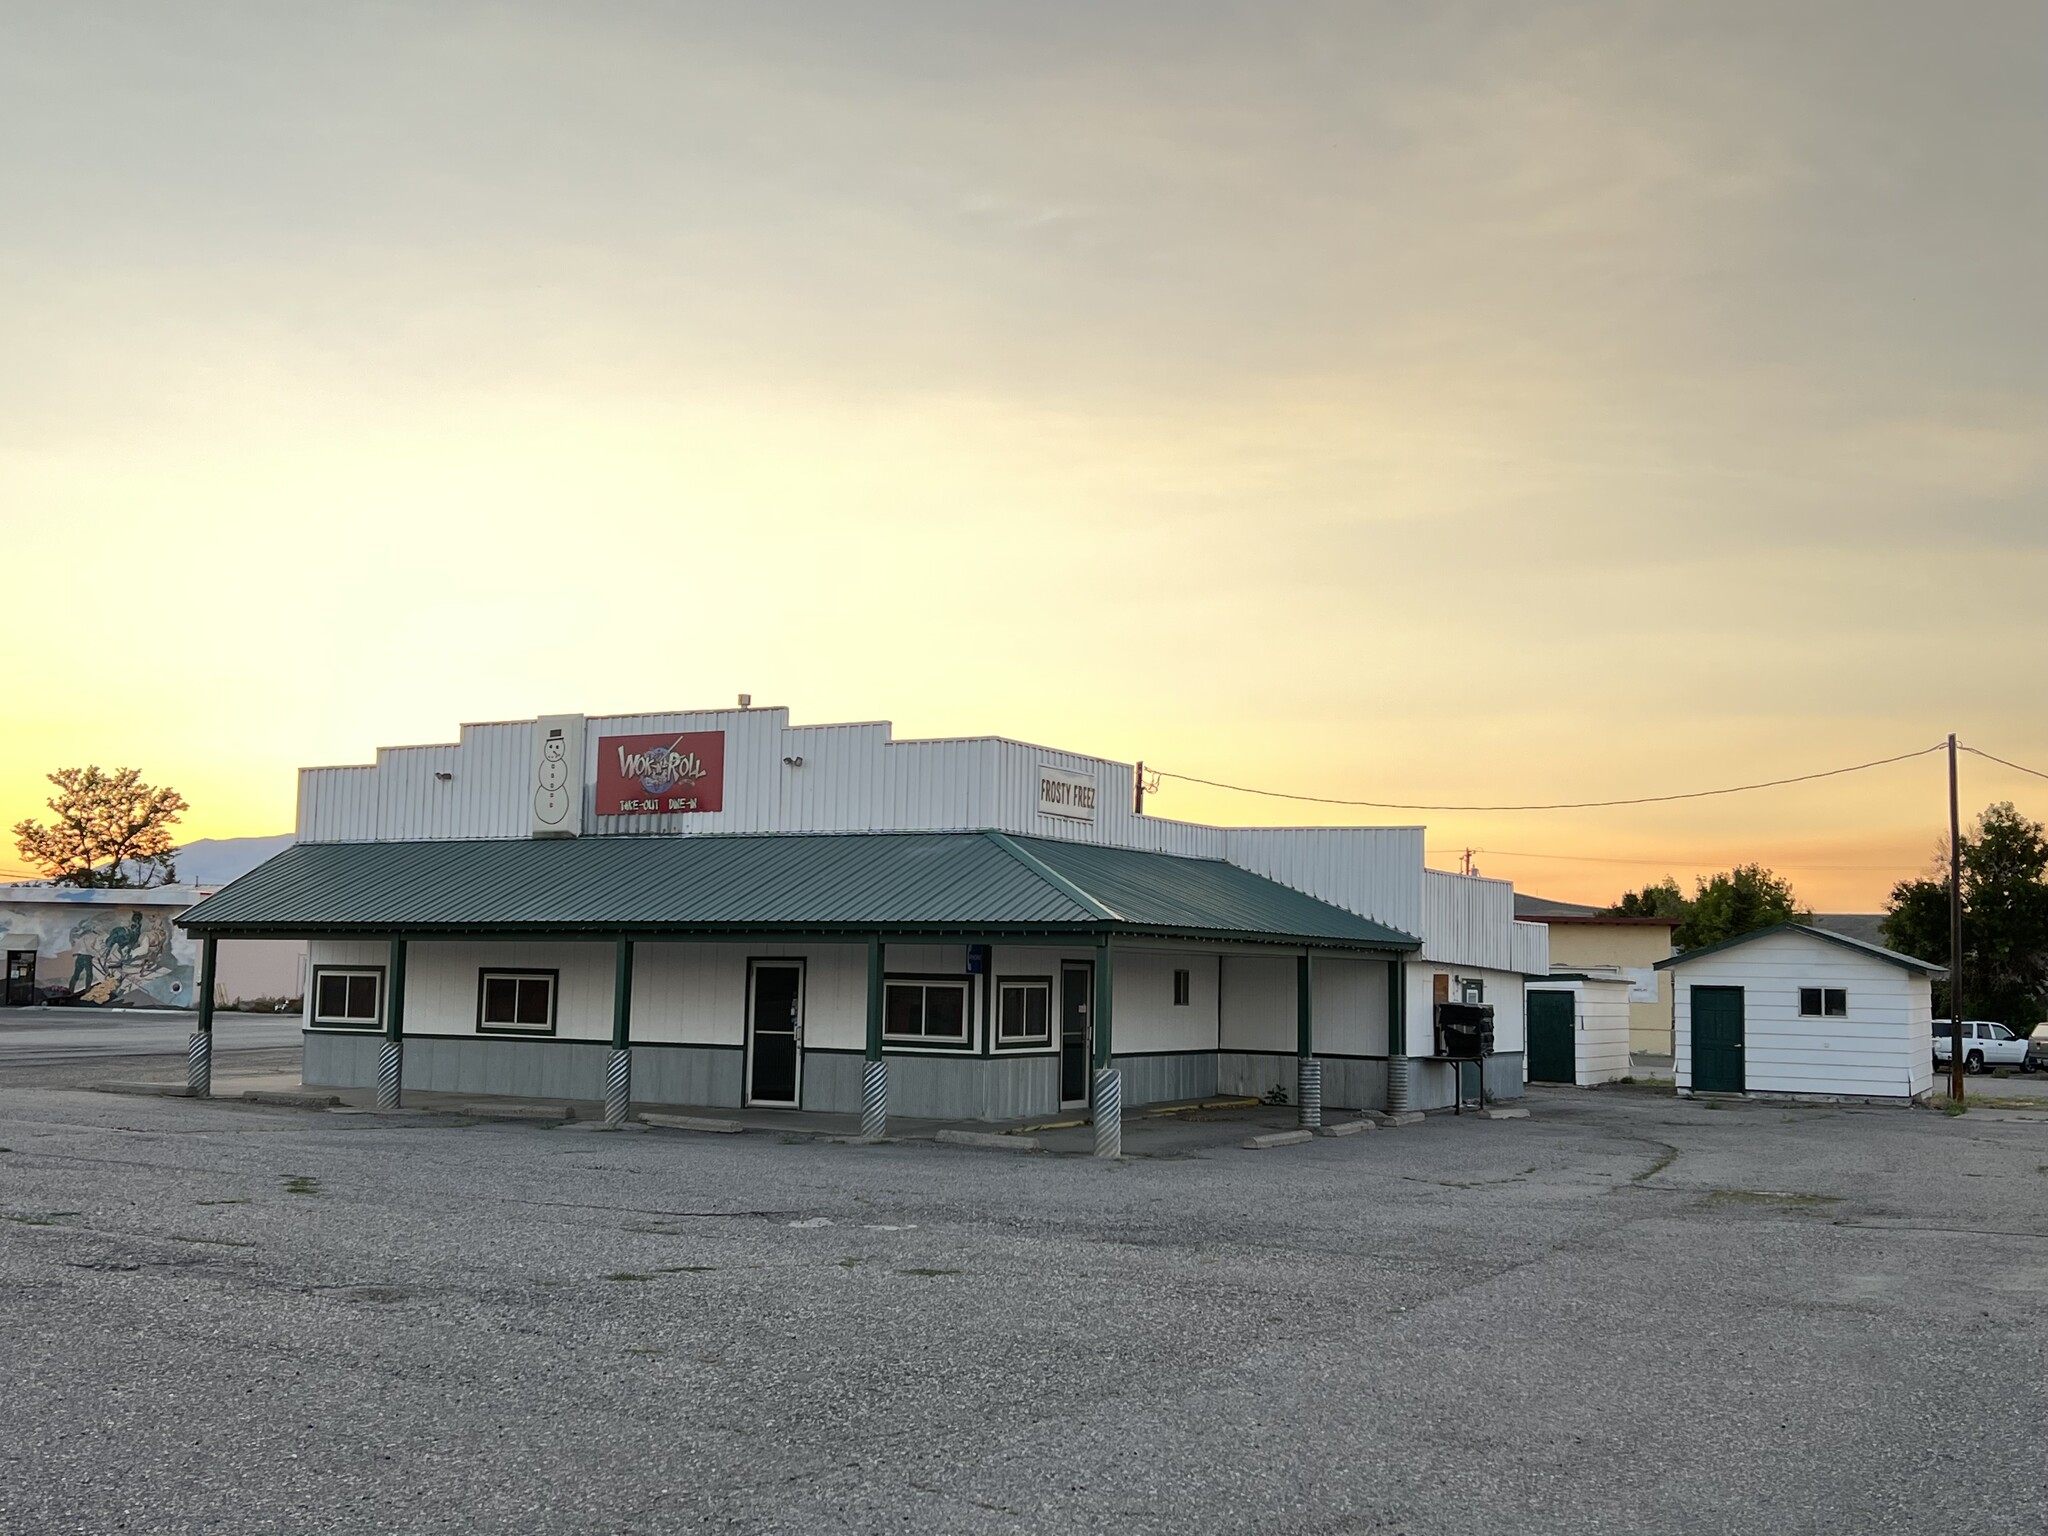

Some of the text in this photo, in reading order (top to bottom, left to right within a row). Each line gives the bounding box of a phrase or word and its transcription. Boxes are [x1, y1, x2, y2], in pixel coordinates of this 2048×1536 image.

[619, 798, 660, 812] TAKE-OUT
[1040, 778, 1096, 810] FROSTY FREEZ
